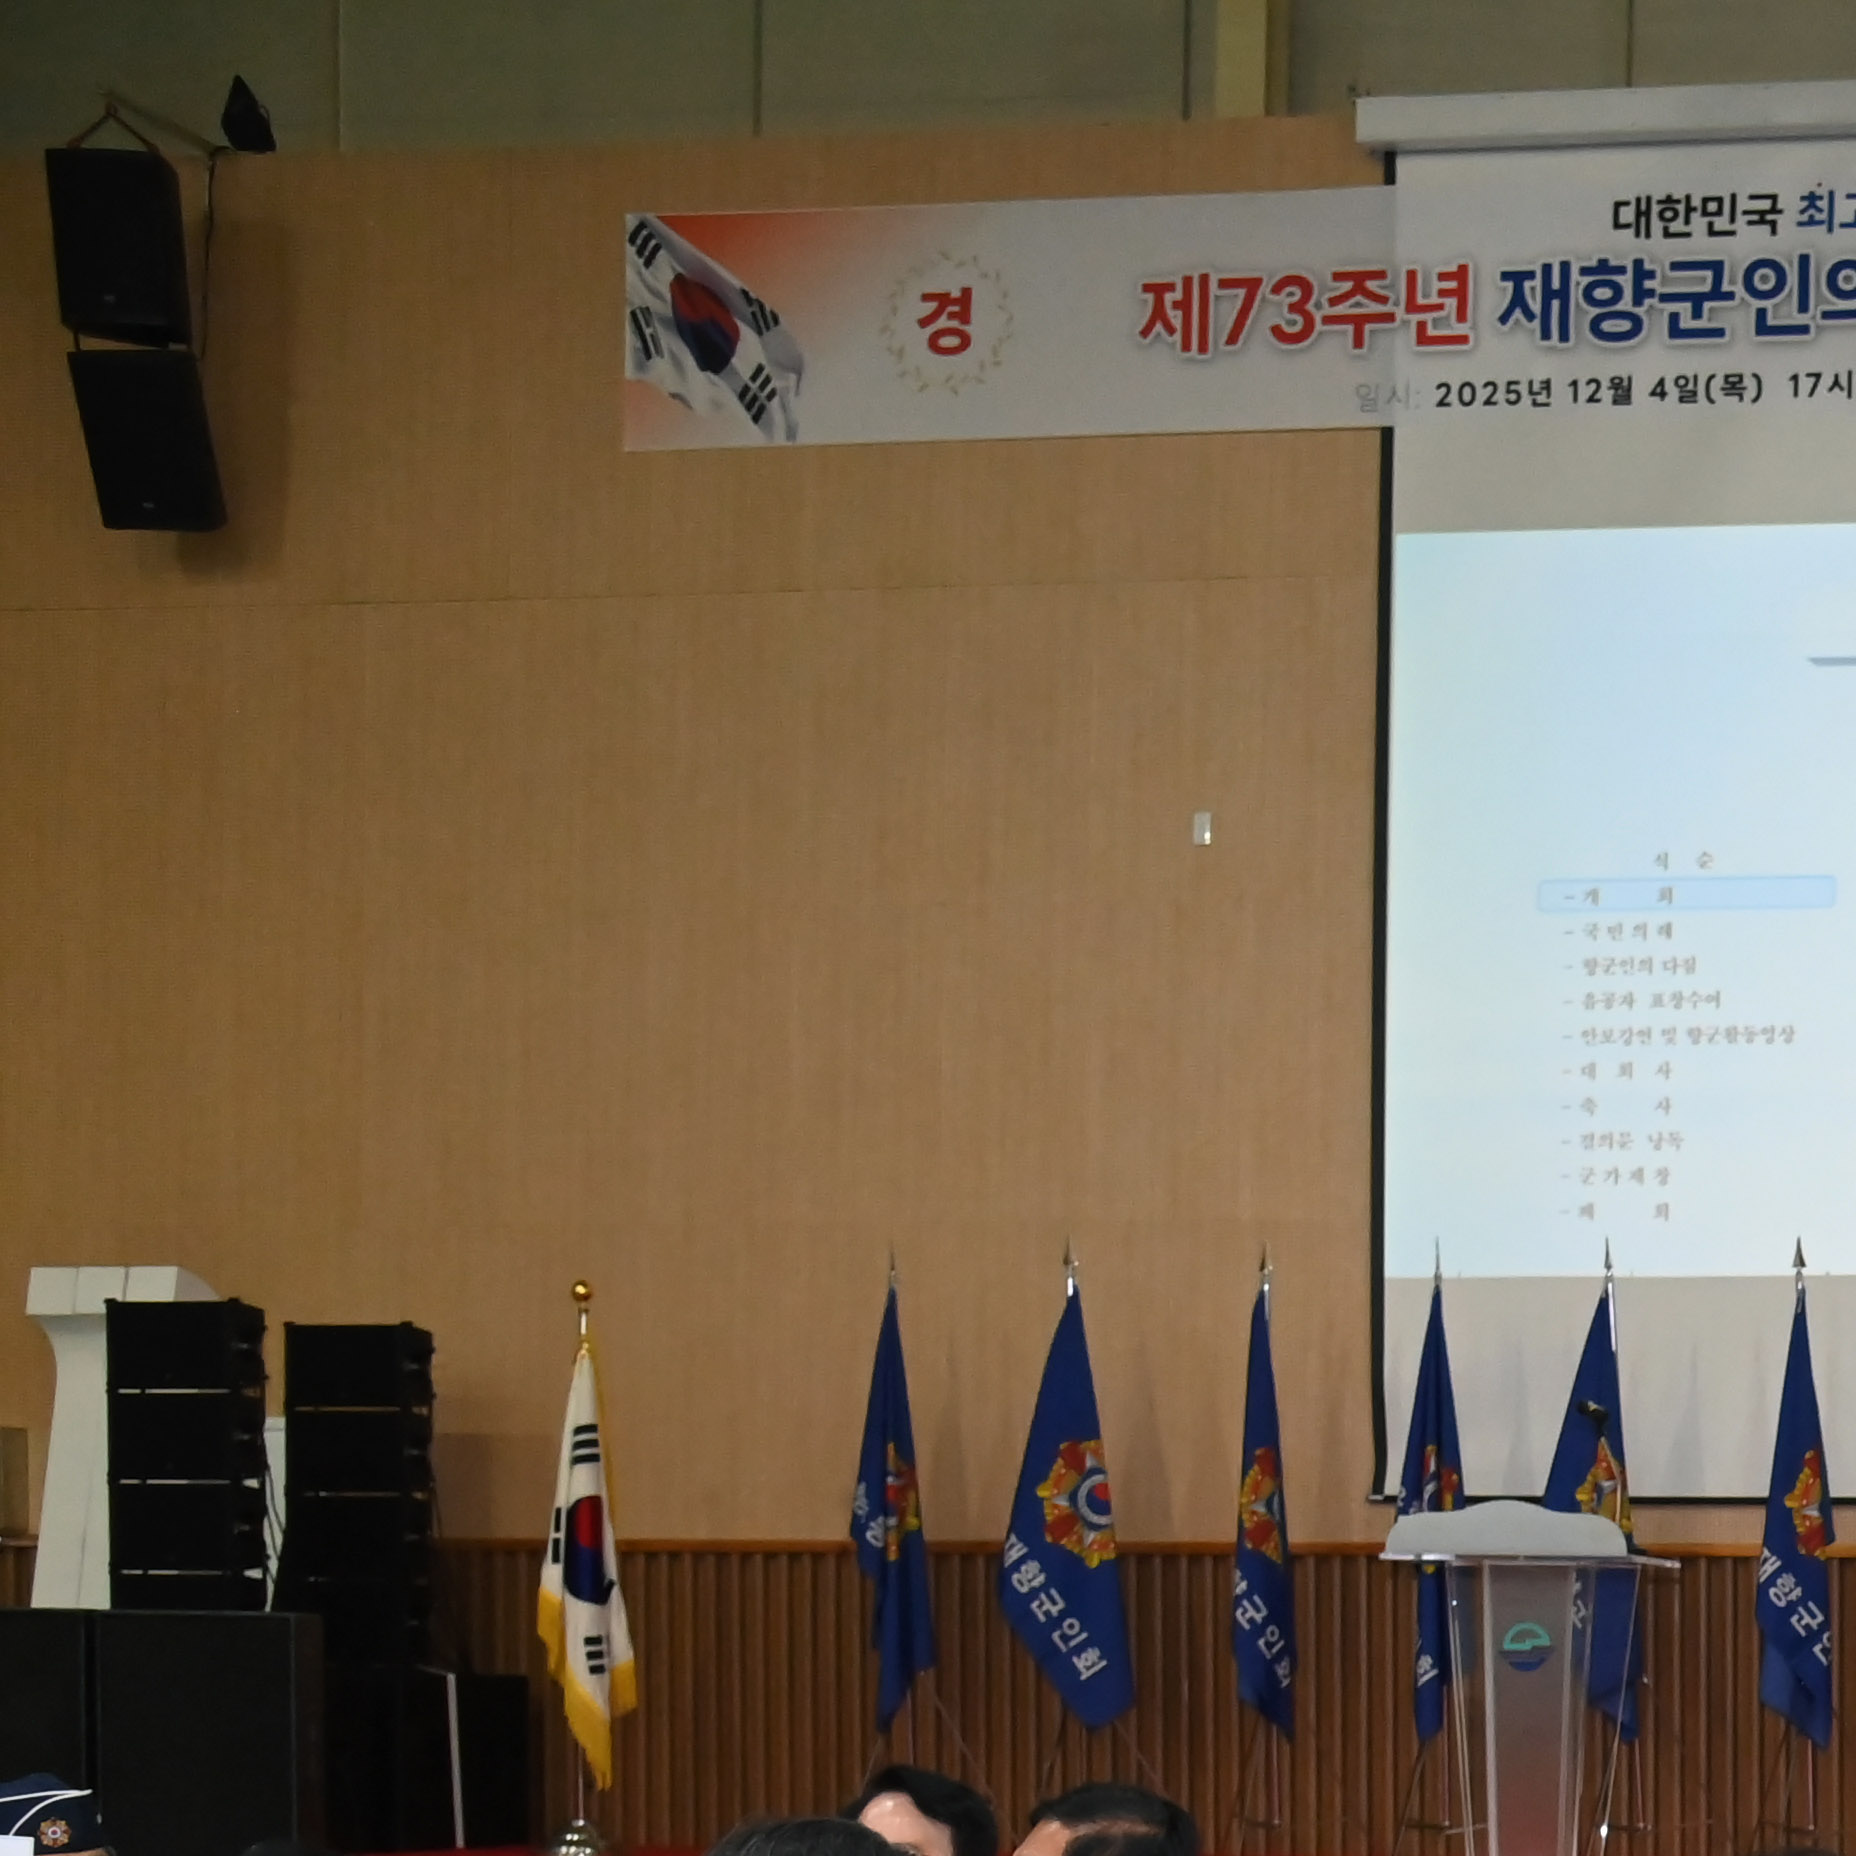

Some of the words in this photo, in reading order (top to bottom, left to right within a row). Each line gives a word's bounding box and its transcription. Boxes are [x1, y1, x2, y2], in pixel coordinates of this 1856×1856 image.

[1612, 194, 1783, 239] 대한민국
[917, 287, 973, 356] 경
[1138, 263, 1470, 354] 제73주년
[1434, 379, 1552, 408] 2025년
[1567, 375, 1634, 406] 12월
[1648, 372, 1763, 404] 4일(목)
[1788, 370, 1854, 400] 17시
